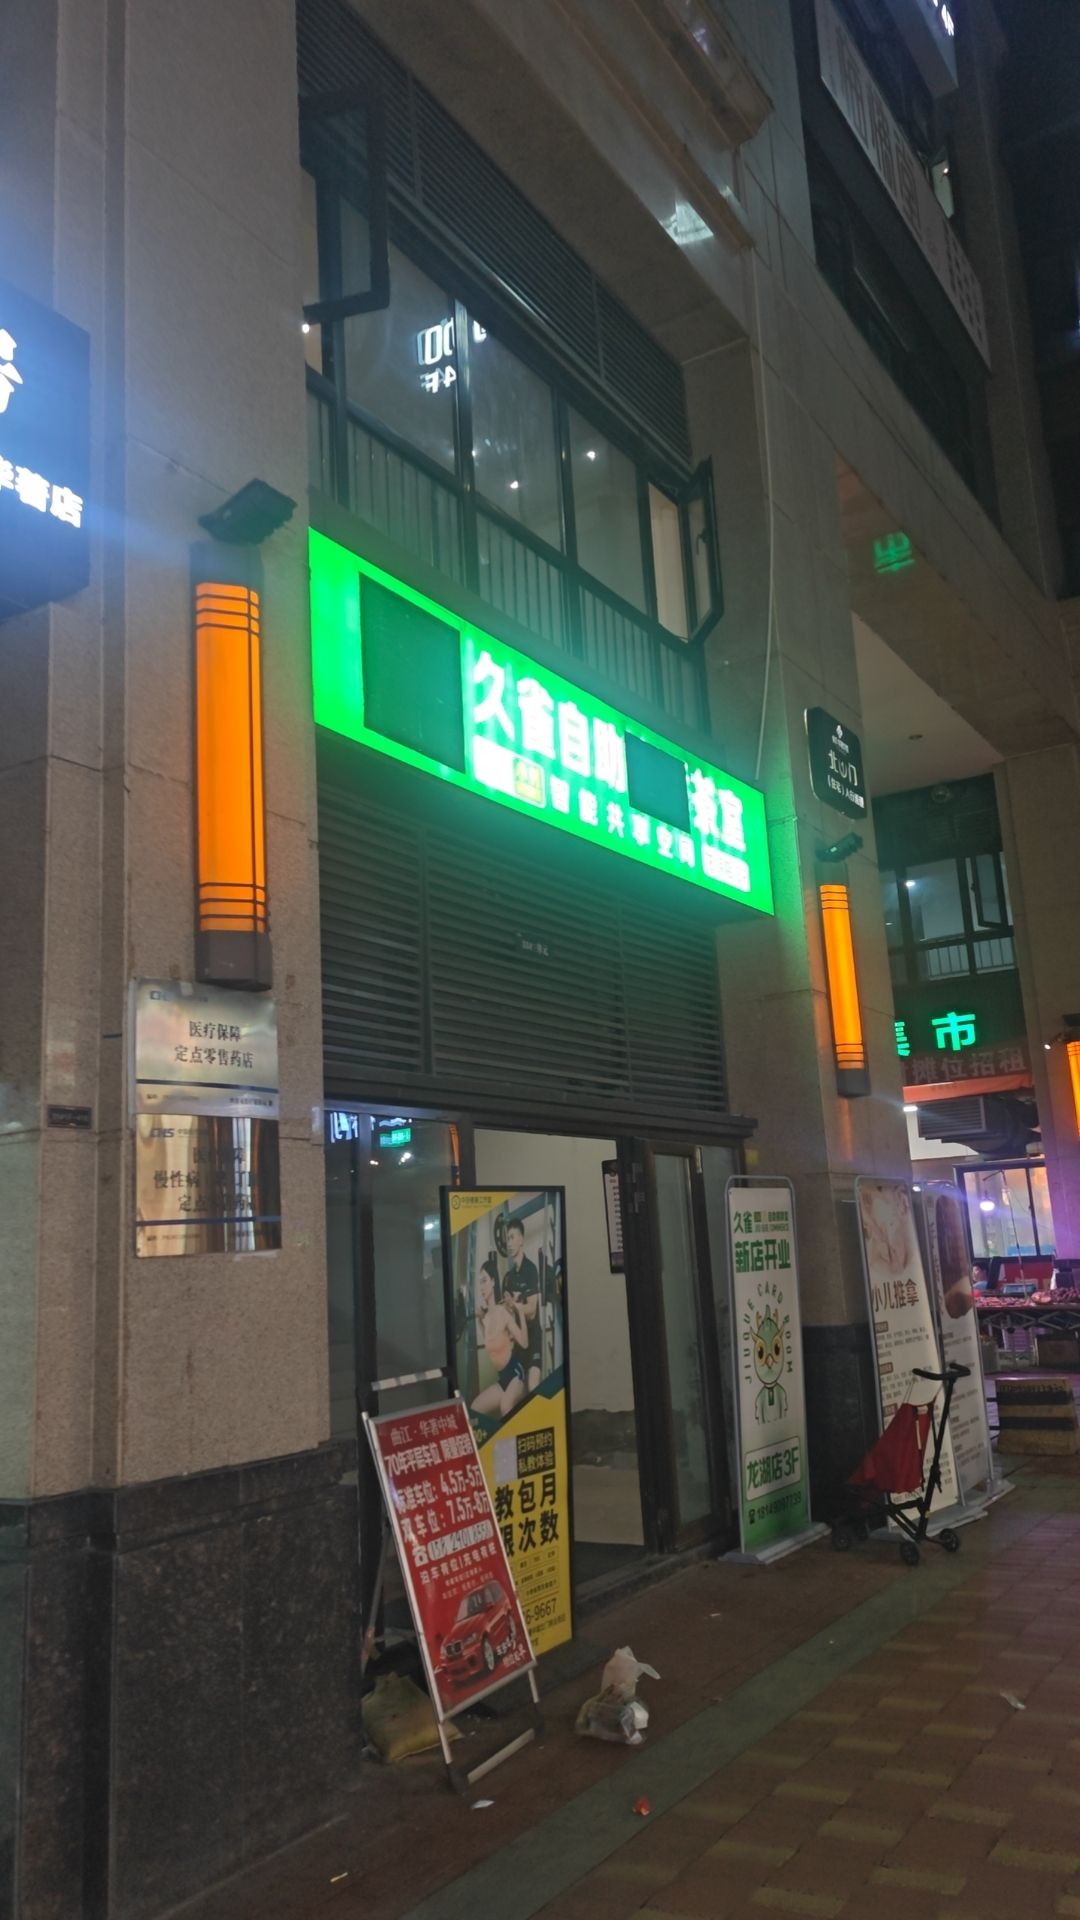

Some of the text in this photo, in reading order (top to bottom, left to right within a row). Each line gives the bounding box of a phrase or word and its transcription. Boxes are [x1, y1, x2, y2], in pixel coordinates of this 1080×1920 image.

[189, 1020, 241, 1043] 医疗保障
[174, 1044, 254, 1069] 定点零售药店
[735, 1239, 791, 1273] 新店开业
[871, 1277, 919, 1313] 小儿推拿
